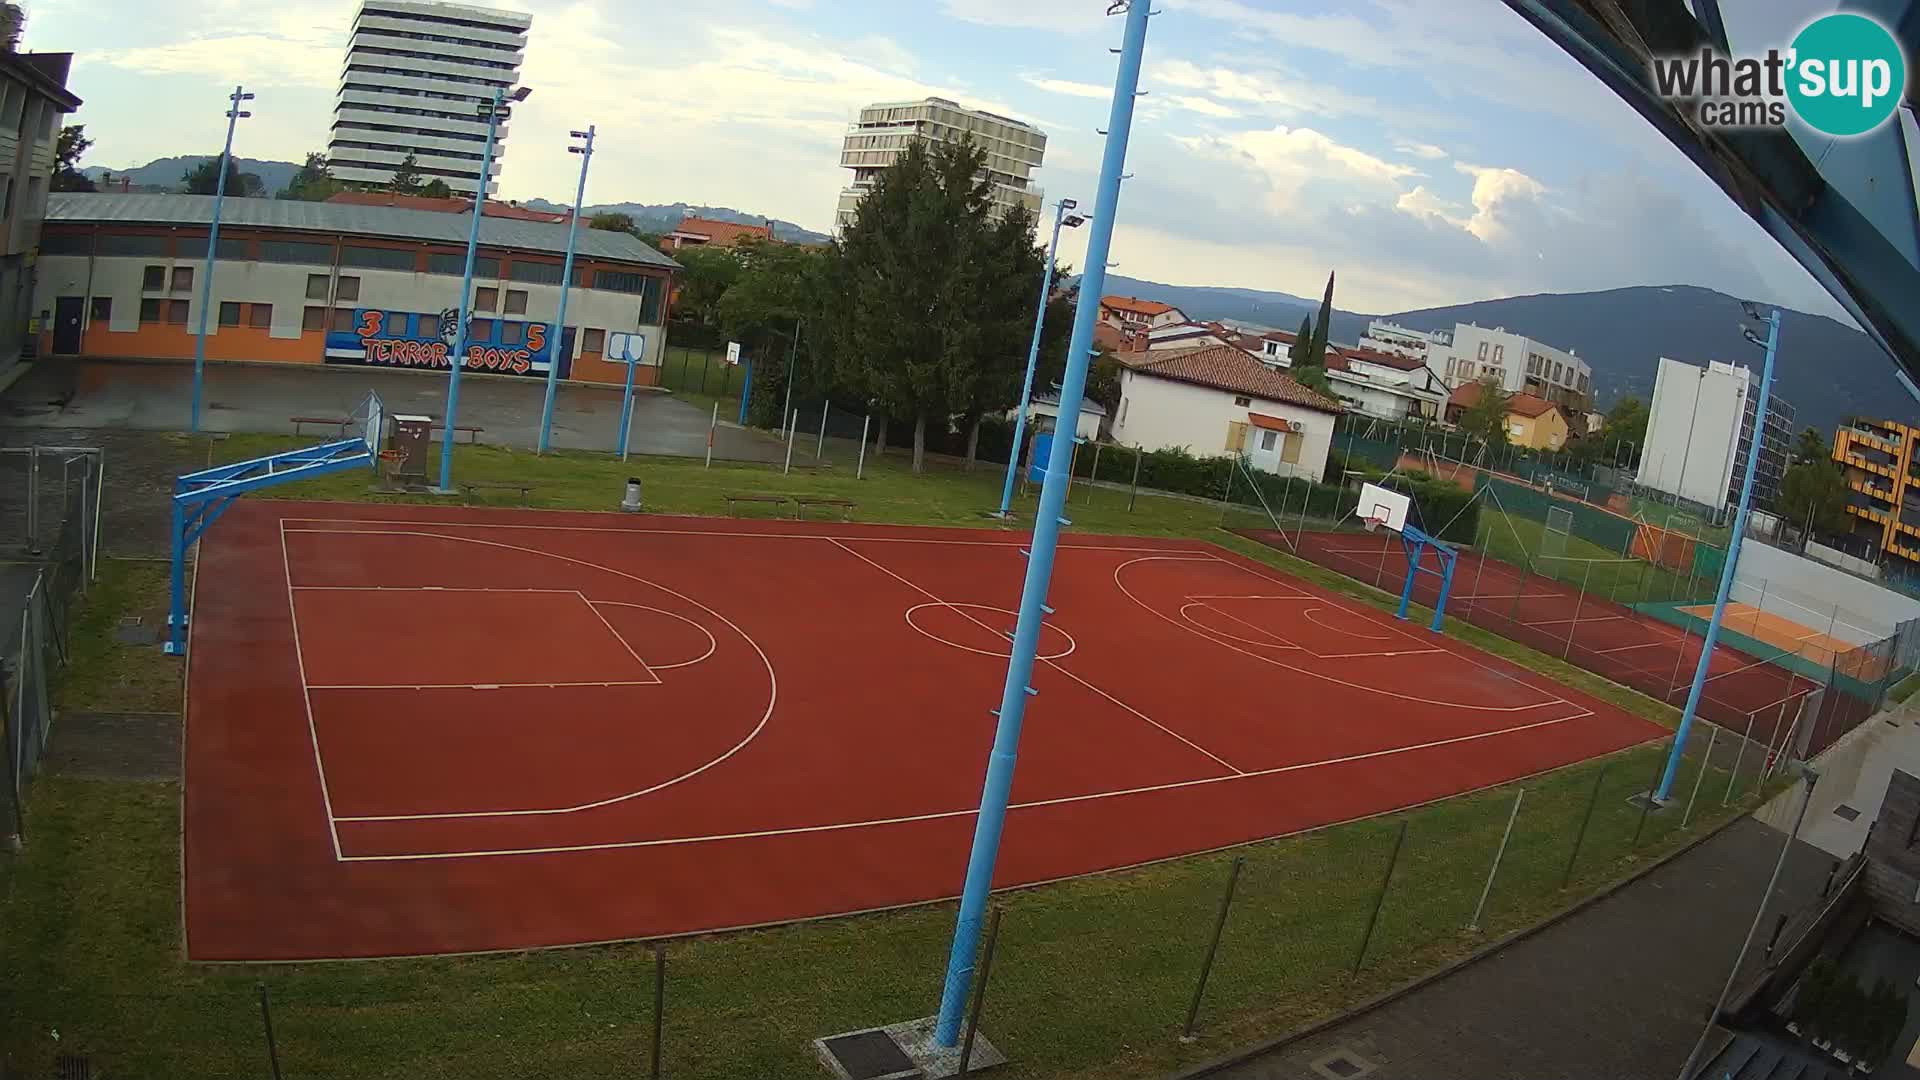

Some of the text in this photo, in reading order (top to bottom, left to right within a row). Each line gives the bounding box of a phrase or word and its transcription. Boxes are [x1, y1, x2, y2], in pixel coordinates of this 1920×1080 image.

[358, 311, 383, 337] 3
[527, 325, 546, 351] 5
[362, 339, 530, 374] TERROR BOYS
